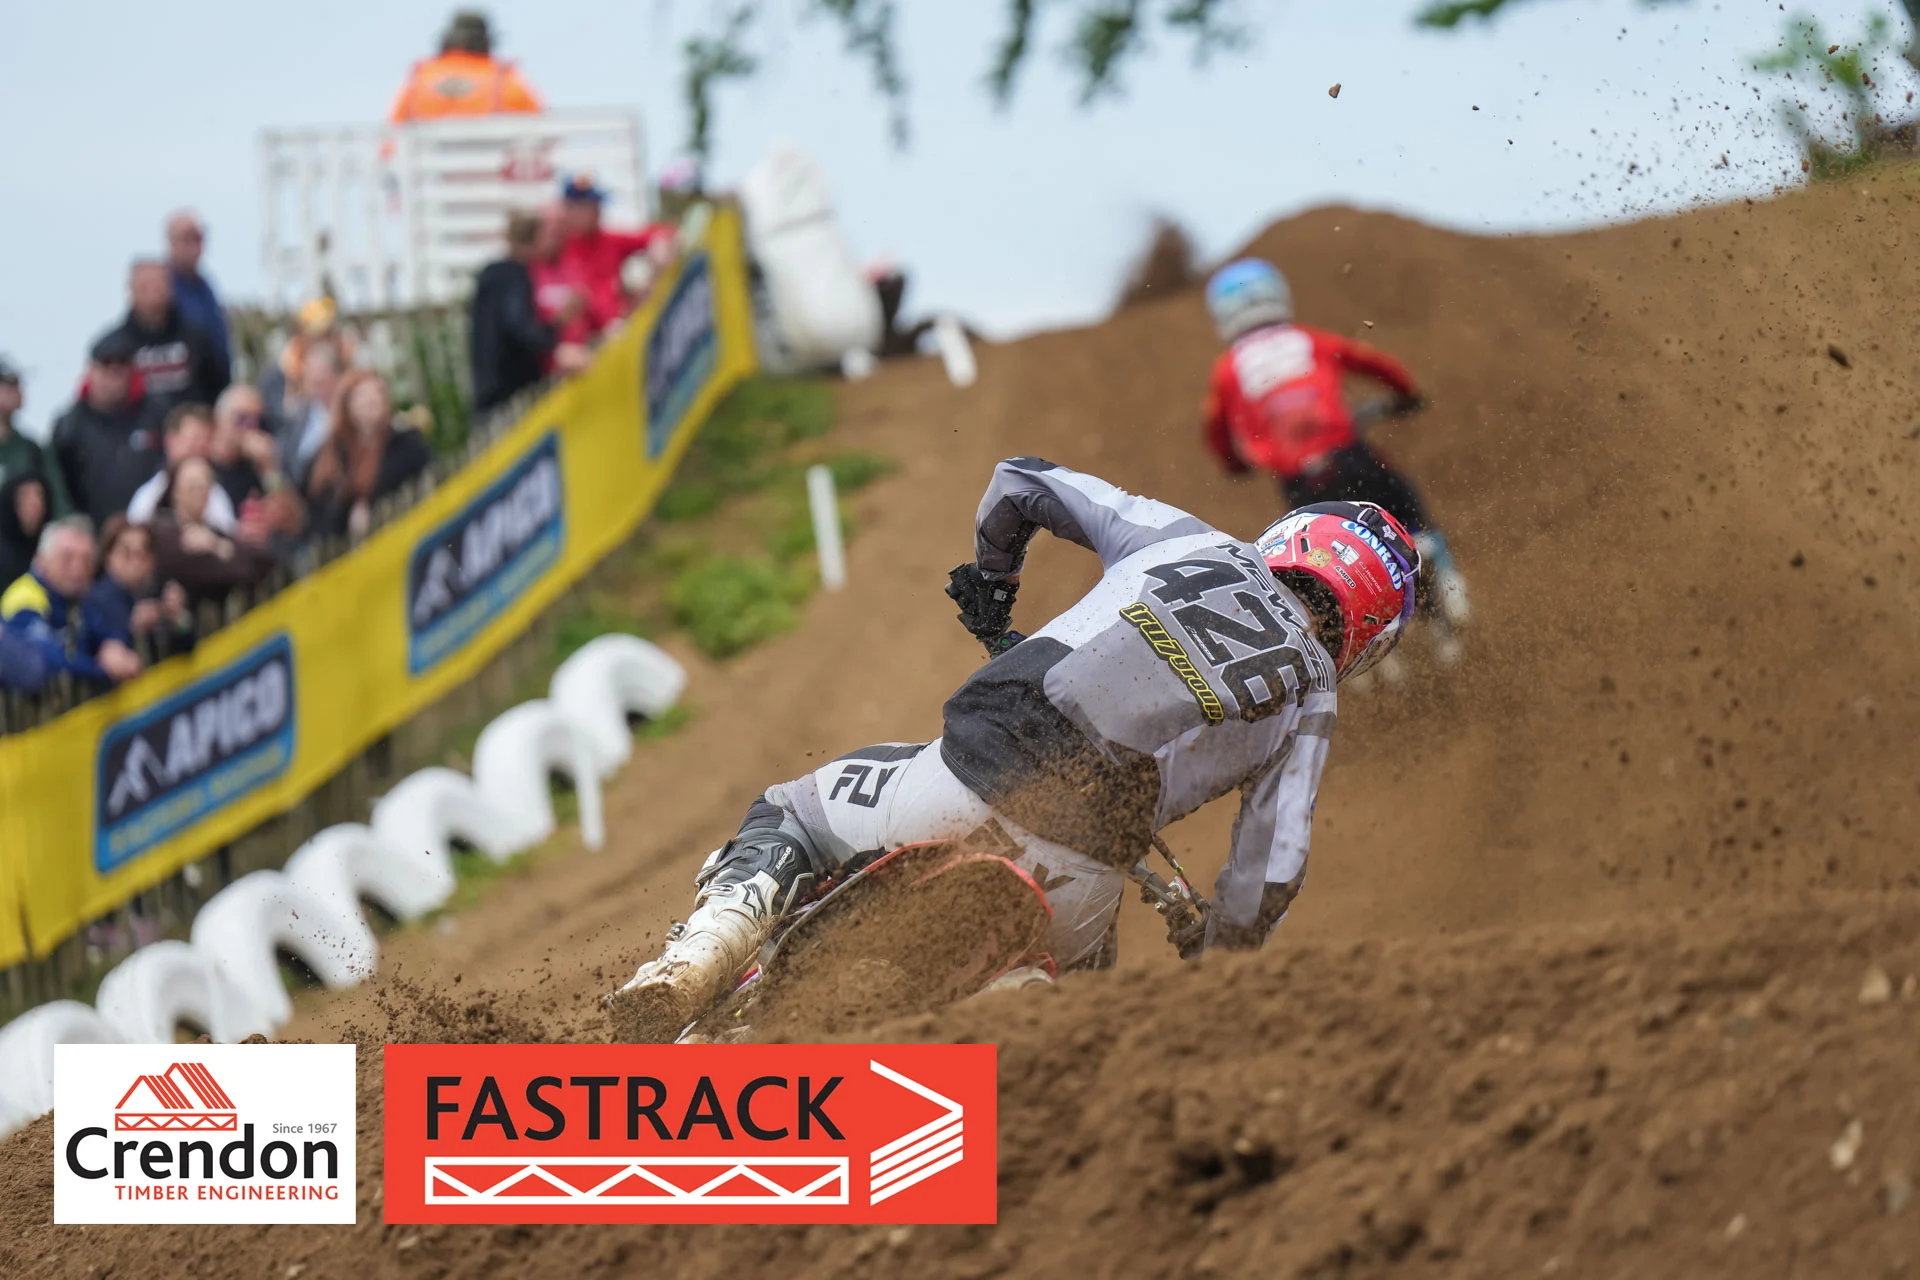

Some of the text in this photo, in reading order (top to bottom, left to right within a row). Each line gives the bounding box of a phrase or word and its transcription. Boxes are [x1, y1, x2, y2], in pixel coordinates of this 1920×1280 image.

[1335, 565, 1357, 589] AMPED
[1340, 520, 1402, 591] CONRAD
[1142, 558, 1312, 724] 426
[163, 659, 288, 784] APICO
[829, 764, 900, 809] FLY
